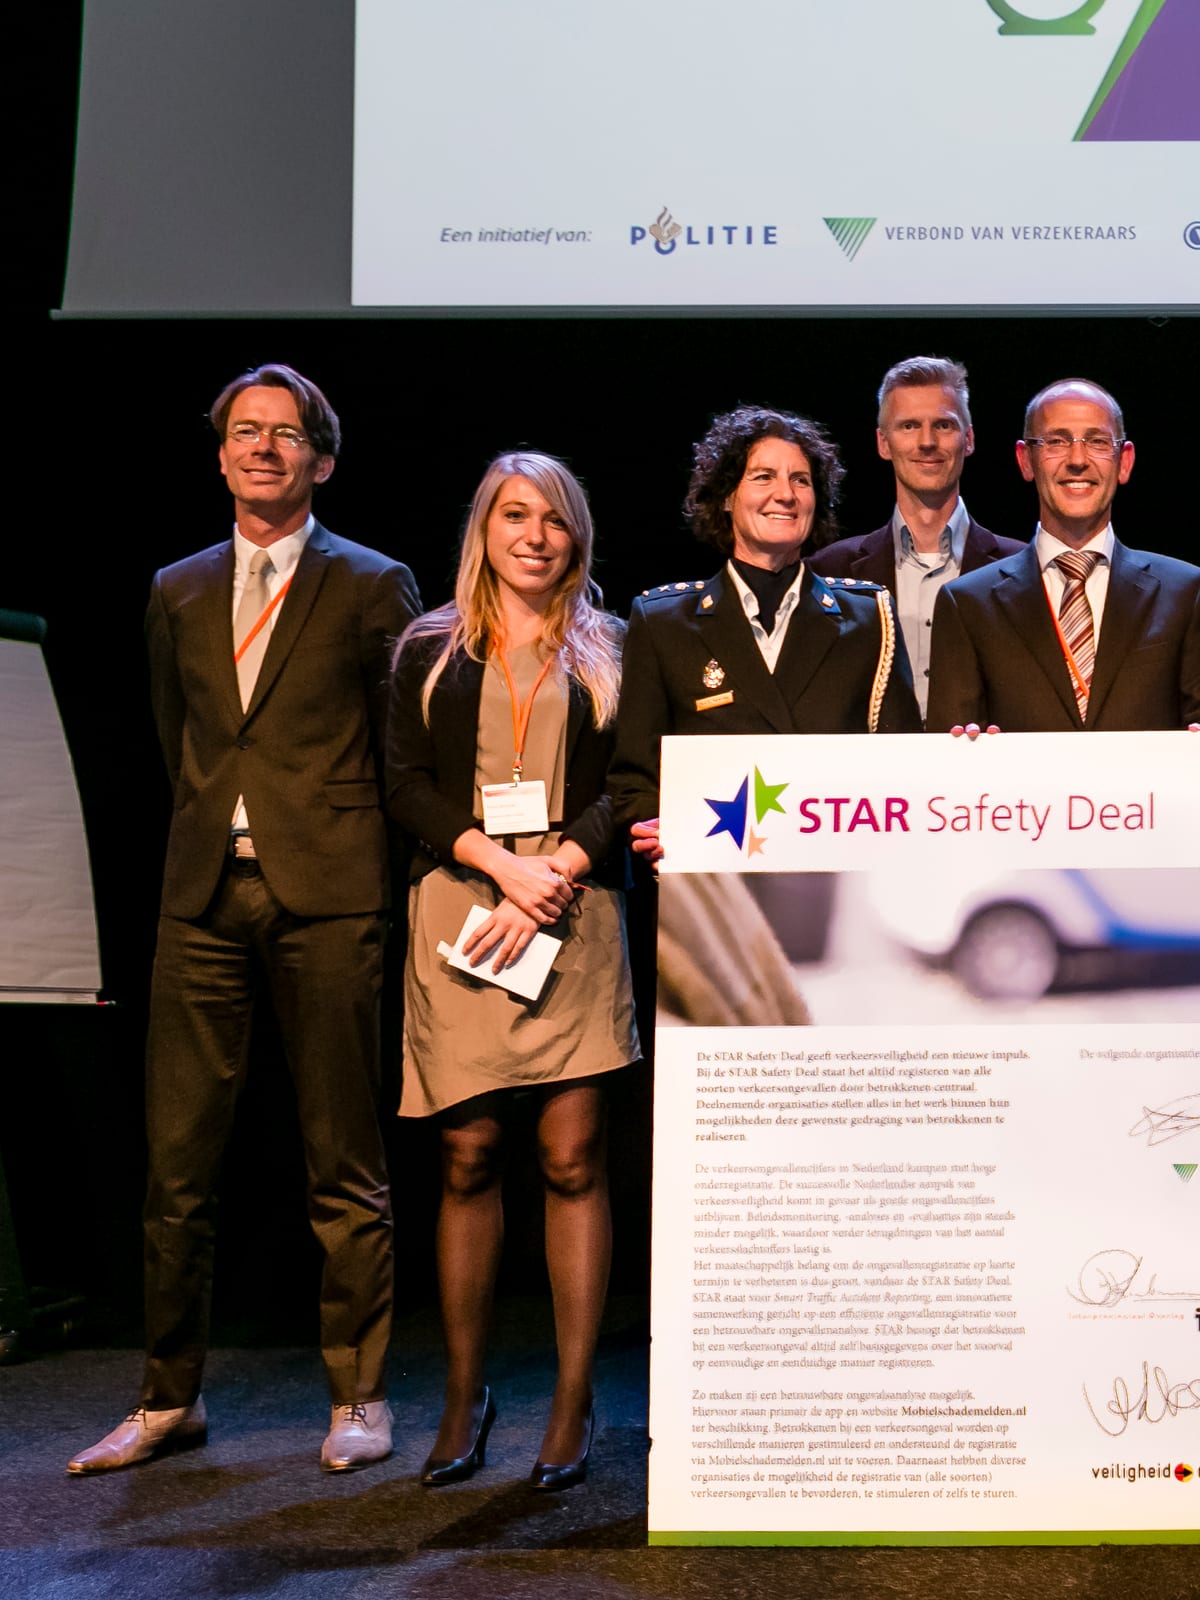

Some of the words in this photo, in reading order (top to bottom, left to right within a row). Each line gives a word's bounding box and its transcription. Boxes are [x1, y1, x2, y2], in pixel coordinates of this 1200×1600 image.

[440, 227, 472, 242] Een
[478, 226, 553, 245] initiatief
[556, 229, 593, 243] van:
[630, 226, 778, 255] POLITIE
[885, 226, 964, 240] VERBOND
[971, 226, 1004, 240] VAN
[1011, 226, 1137, 240] VERZEKERAARS
[799, 797, 910, 833] STAR
[927, 793, 1051, 841] Safety
[1067, 792, 1155, 831] Deal
[901, 1406, 1027, 1416] Mobielschademelden.nl
[1092, 1462, 1171, 1483] veiligheid
